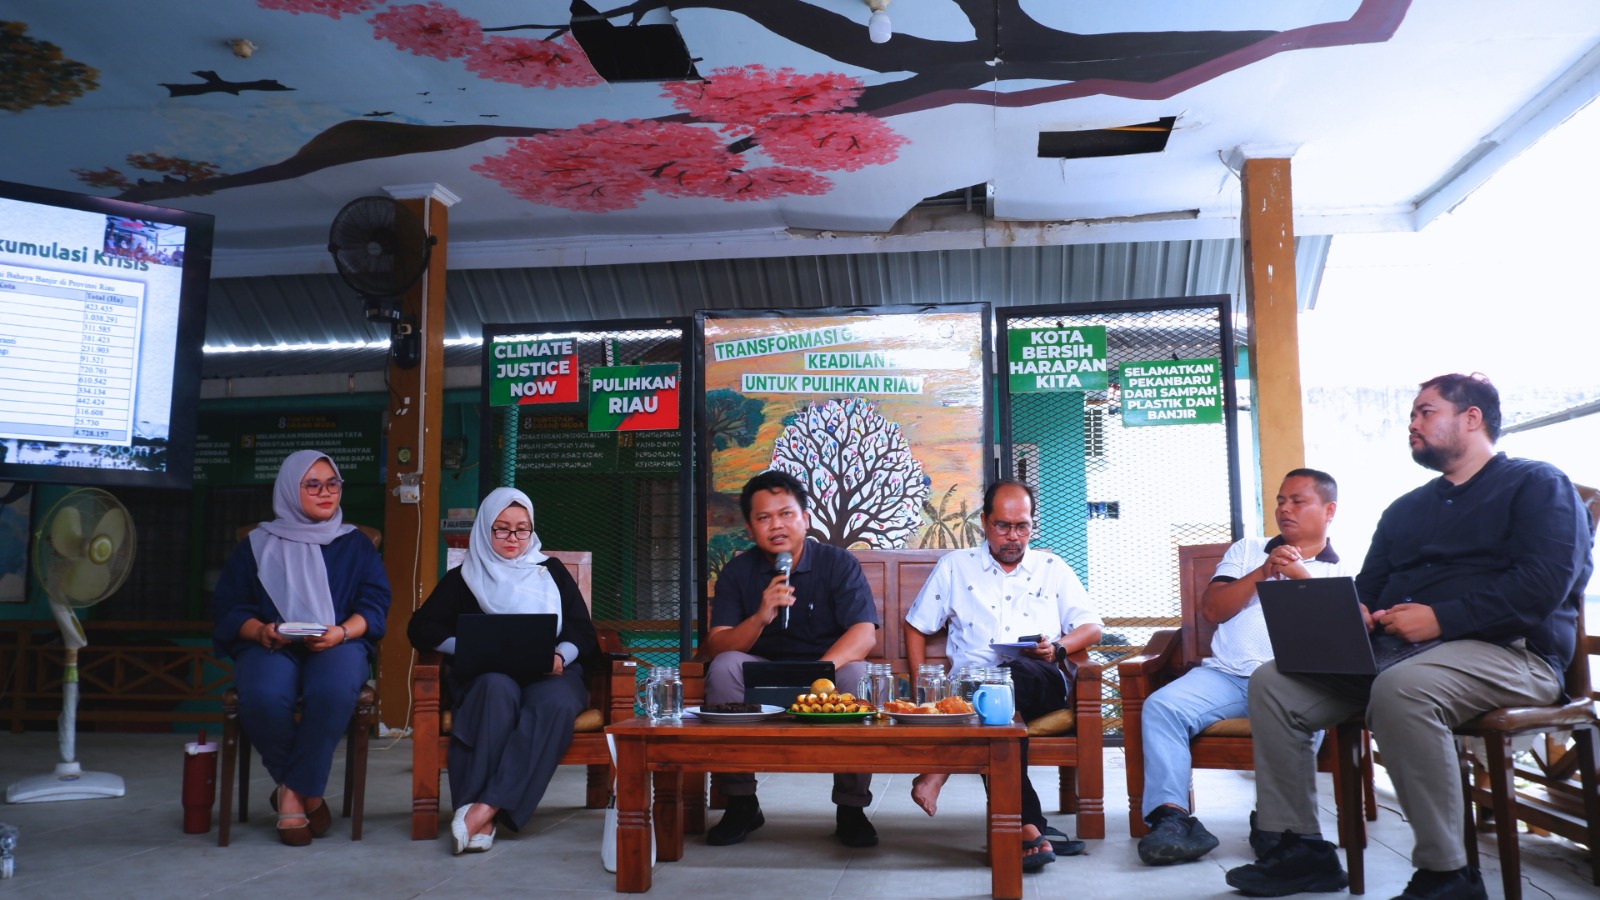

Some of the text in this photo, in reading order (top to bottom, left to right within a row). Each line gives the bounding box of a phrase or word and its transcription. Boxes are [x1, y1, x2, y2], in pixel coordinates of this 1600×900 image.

[68, 280, 97, 290] Provinsi
[99, 283, 115, 291] Riau
[87, 292, 124, 304] Total (Ha)
[85, 304, 112, 312] 423.435
[84, 314, 118, 324] 1.038.291
[83, 324, 110, 332] 311.585
[82, 334, 110, 343] 381.423
[1031, 330, 1084, 344] KOTA
[81, 346, 110, 354] 231.903
[494, 341, 573, 359] CLIMATE
[716, 329, 839, 359] TRANSFORMASI
[1022, 344, 1093, 360] BERSIH
[80, 356, 104, 364] 91.321
[808, 352, 885, 368] KEADILAN
[1010, 358, 1107, 374] HARAPAN
[80, 366, 106, 374] 720.761
[496, 361, 570, 378] JUSTICE
[1124, 364, 1214, 377] SELAMATKAN
[79, 377, 106, 385] 610.542
[592, 376, 676, 392] PULIHKAN
[745, 376, 920, 392] UNTUK PULIHKAN RIAU
[1036, 374, 1082, 388] KITA
[1129, 376, 1211, 388] PEKANBARU
[78, 387, 106, 395] 334.134
[510, 381, 557, 396] NOW
[1124, 386, 1217, 399] DARI SAMPAH
[608, 396, 658, 414] RIAU
[1128, 398, 1215, 410] PLASTIK DAN
[76, 408, 104, 416] 116.608
[1148, 409, 1196, 420] BANJIR
[75, 418, 99, 426] 25.730
[278, 416, 287, 429] 8
[74, 430, 109, 438] 4.728.157
[244, 436, 251, 448] 5
